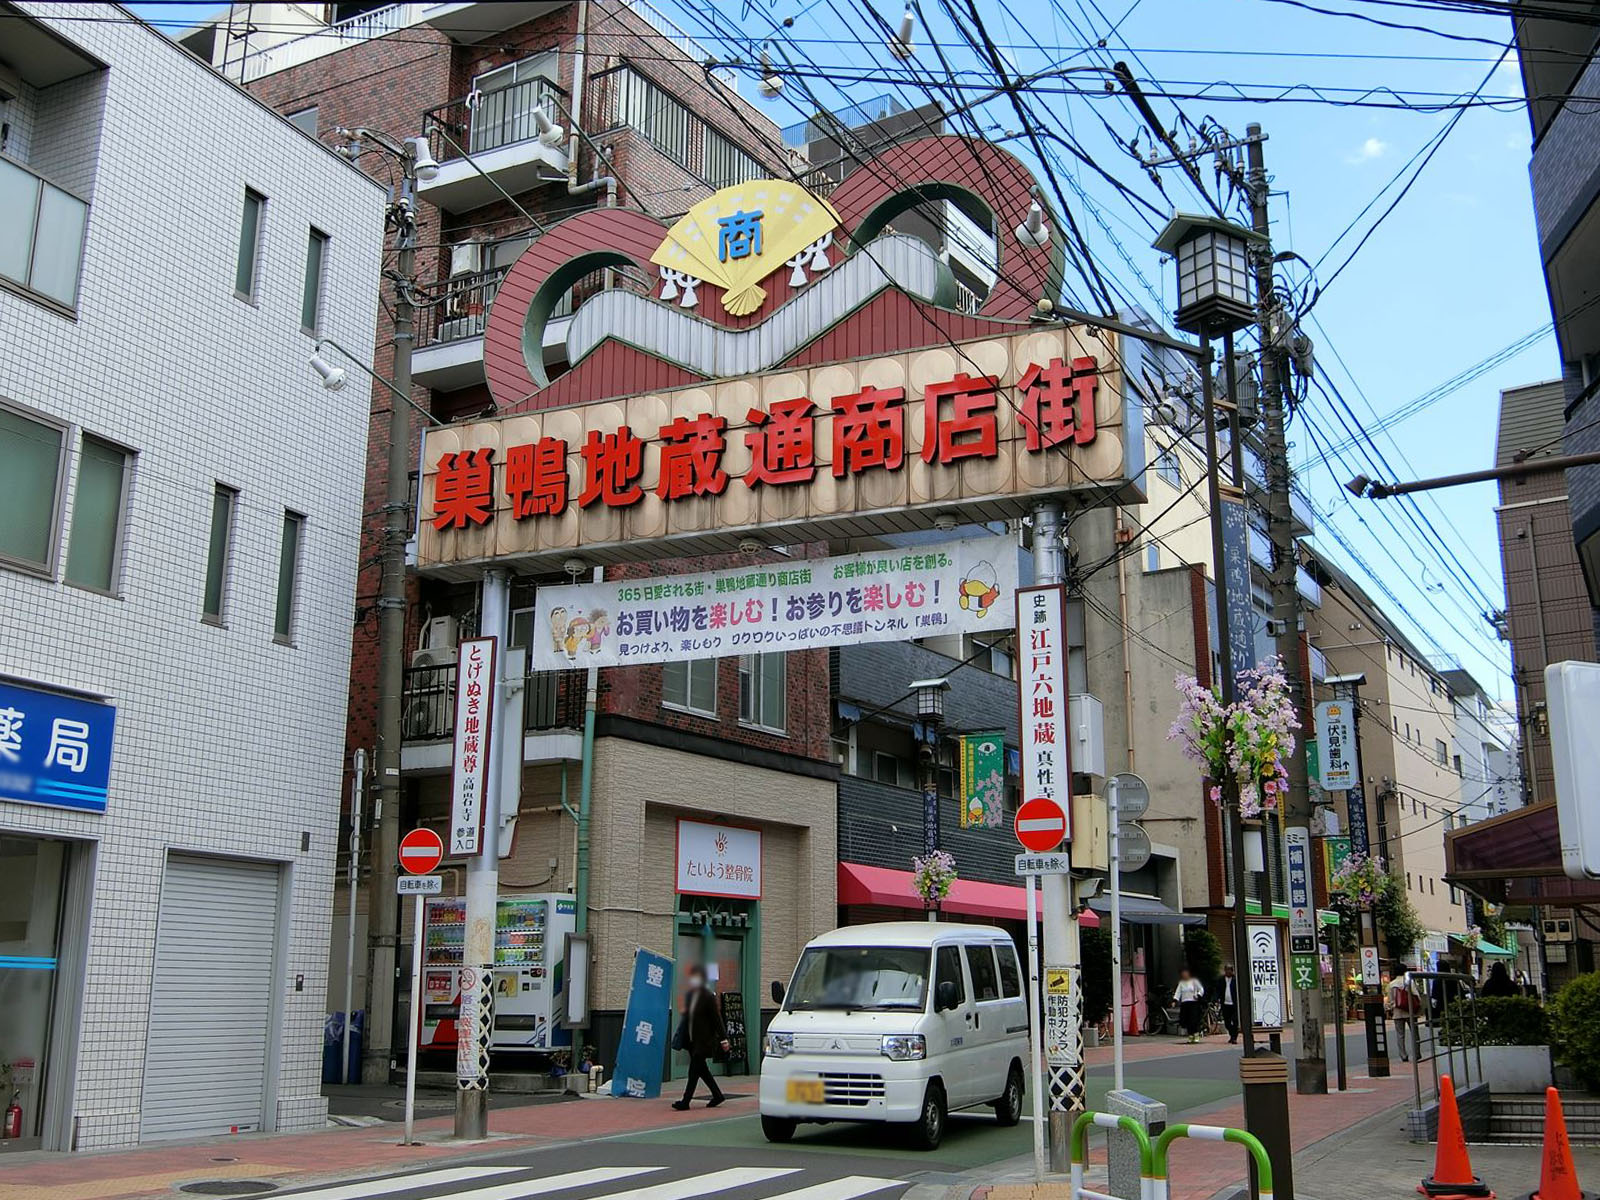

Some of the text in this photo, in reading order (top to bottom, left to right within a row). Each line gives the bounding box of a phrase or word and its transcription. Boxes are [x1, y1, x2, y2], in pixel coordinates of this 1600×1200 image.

[717, 210, 764, 262] 商
[432, 356, 1099, 529] 巣鴨地蔵通商店街
[1033, 594, 1047, 624] 史跡
[1031, 628, 1056, 745] 江戸六地蔵
[462, 645, 484, 822] とげぬき地蔵尊 高岩寺
[1327, 725, 1342, 770] 伏見歯科
[455, 839, 475, 850] 入口
[456, 826, 475, 838] 参道
[687, 859, 753, 882] たいよう整骨院
[1018, 857, 1065, 871] 自転車を除く
[1290, 850, 1306, 904] 補聴器
[400, 879, 438, 890] 自転車を除く
[1253, 960, 1277, 973] FREE
[1253, 973, 1278, 986] Wi-Fi
[1363, 960, 1376, 979] 令和
[626, 963, 664, 1098] 整骨院
[1057, 995, 1069, 1050] 防犯カメラ
